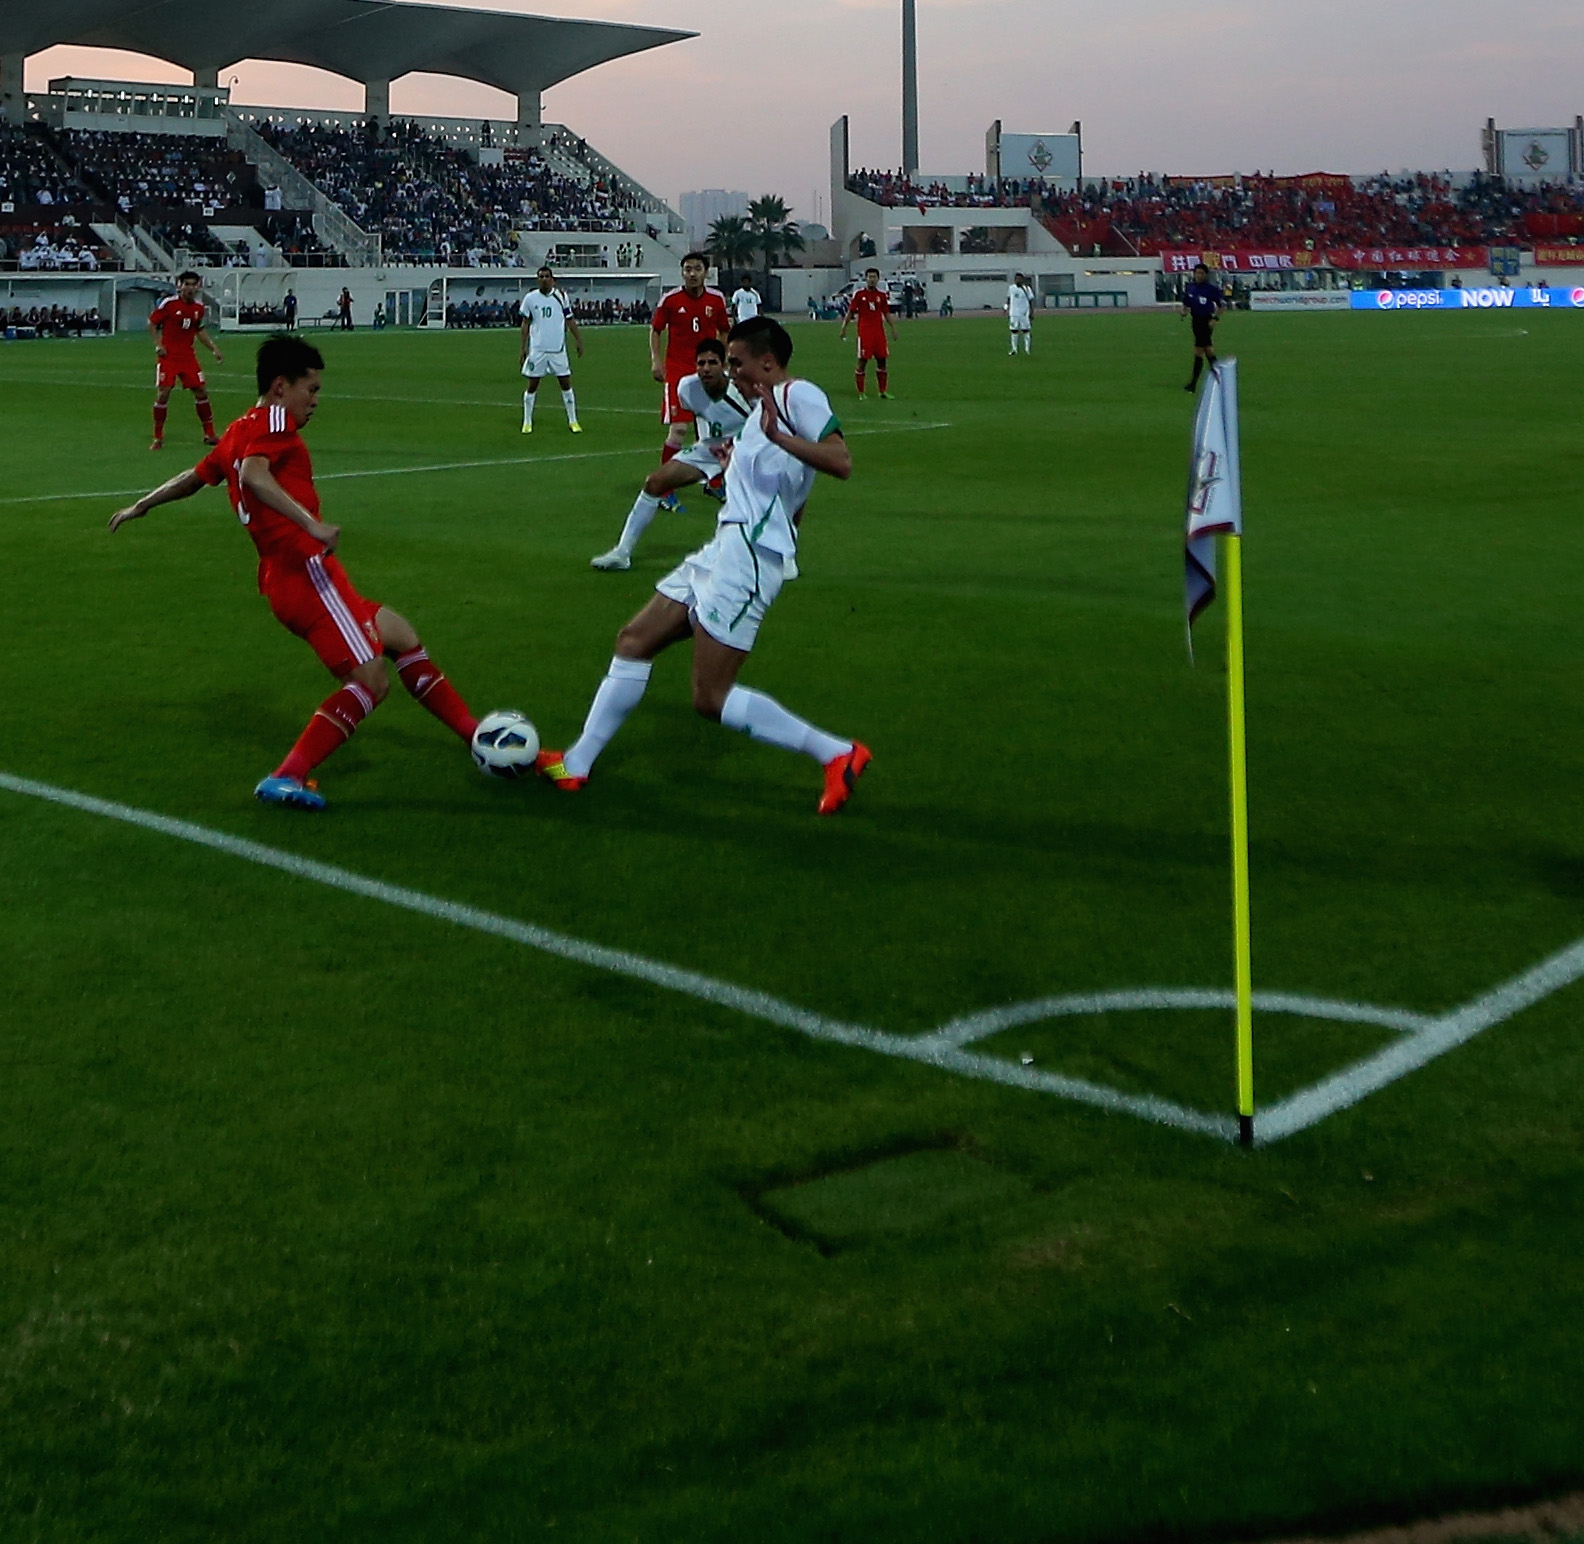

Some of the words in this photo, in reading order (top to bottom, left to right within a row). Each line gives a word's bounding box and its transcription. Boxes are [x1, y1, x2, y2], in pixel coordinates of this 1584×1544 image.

[1396, 290, 1440, 308] pepsi
[1461, 290, 1515, 307] NOW
[1531, 288, 1550, 307] يلا
[541, 306, 552, 318] 10
[692, 316, 700, 333] 6
[708, 421, 723, 439] 16
